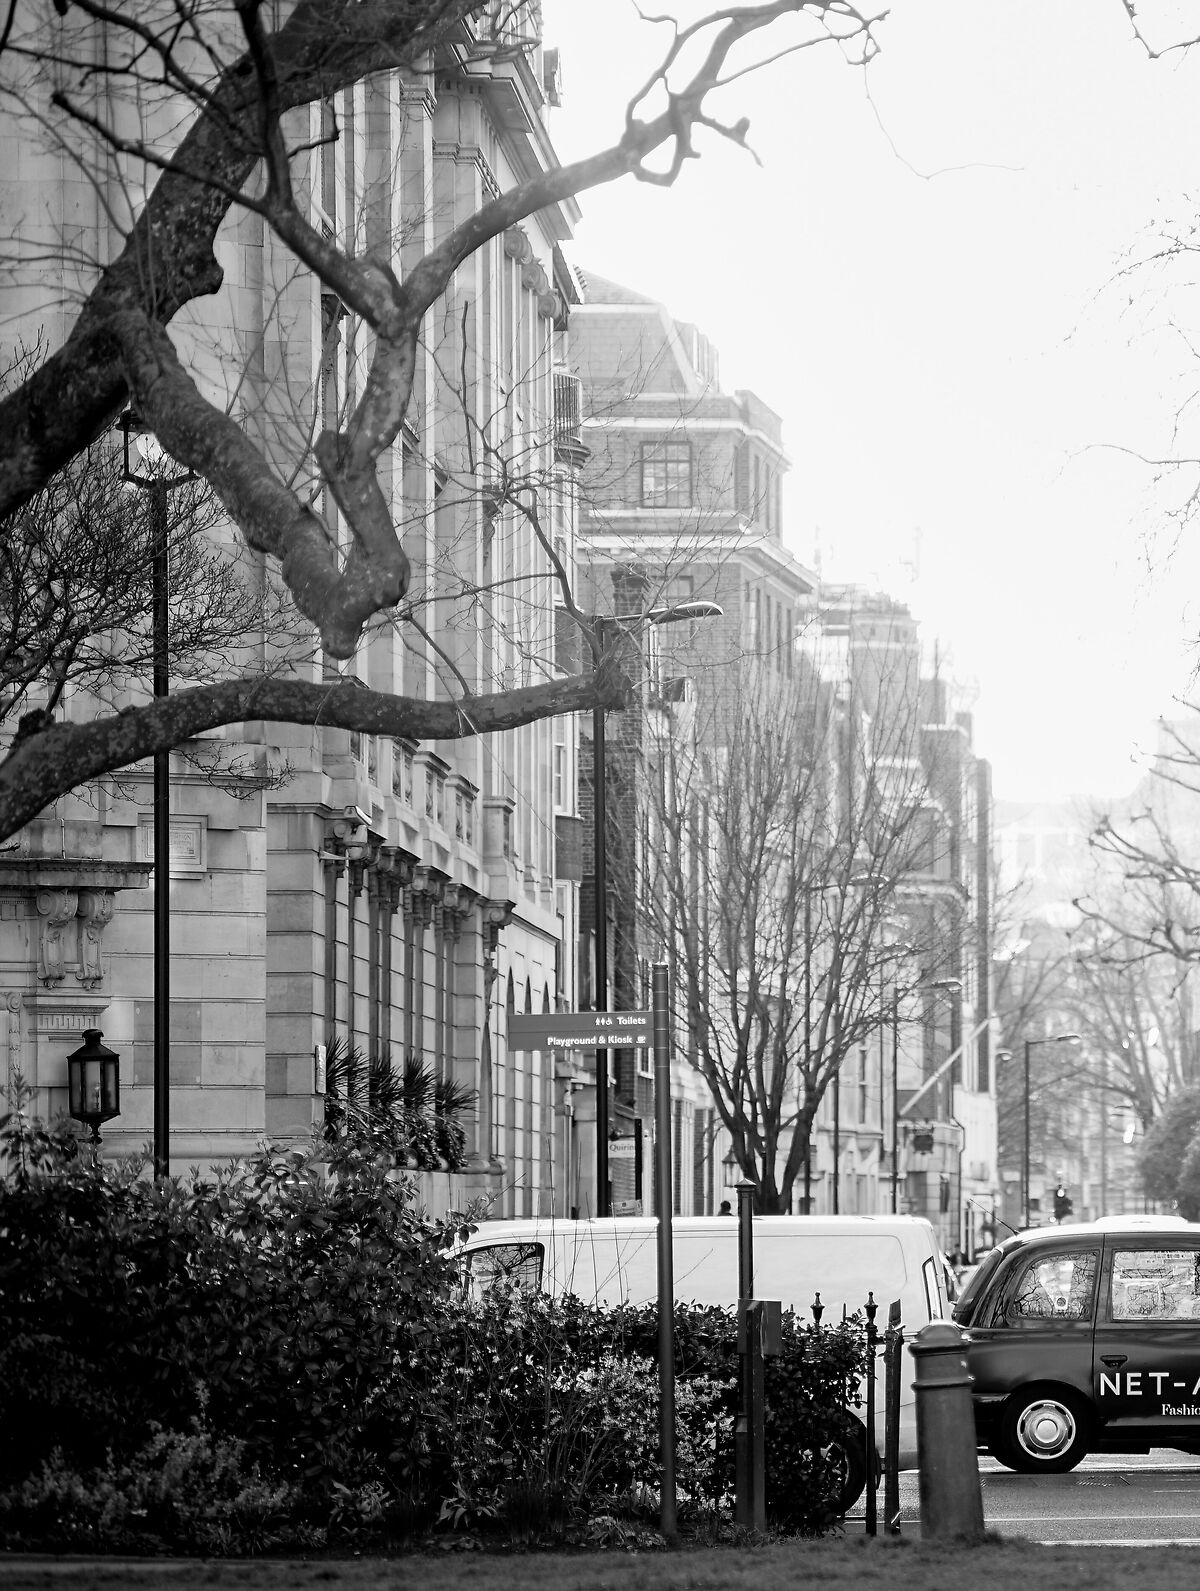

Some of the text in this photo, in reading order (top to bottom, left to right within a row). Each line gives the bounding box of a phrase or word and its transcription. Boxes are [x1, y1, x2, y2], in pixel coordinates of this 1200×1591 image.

[617, 1016, 646, 1026] Toilets
[547, 1035, 633, 1047] Playground & Kiosk
